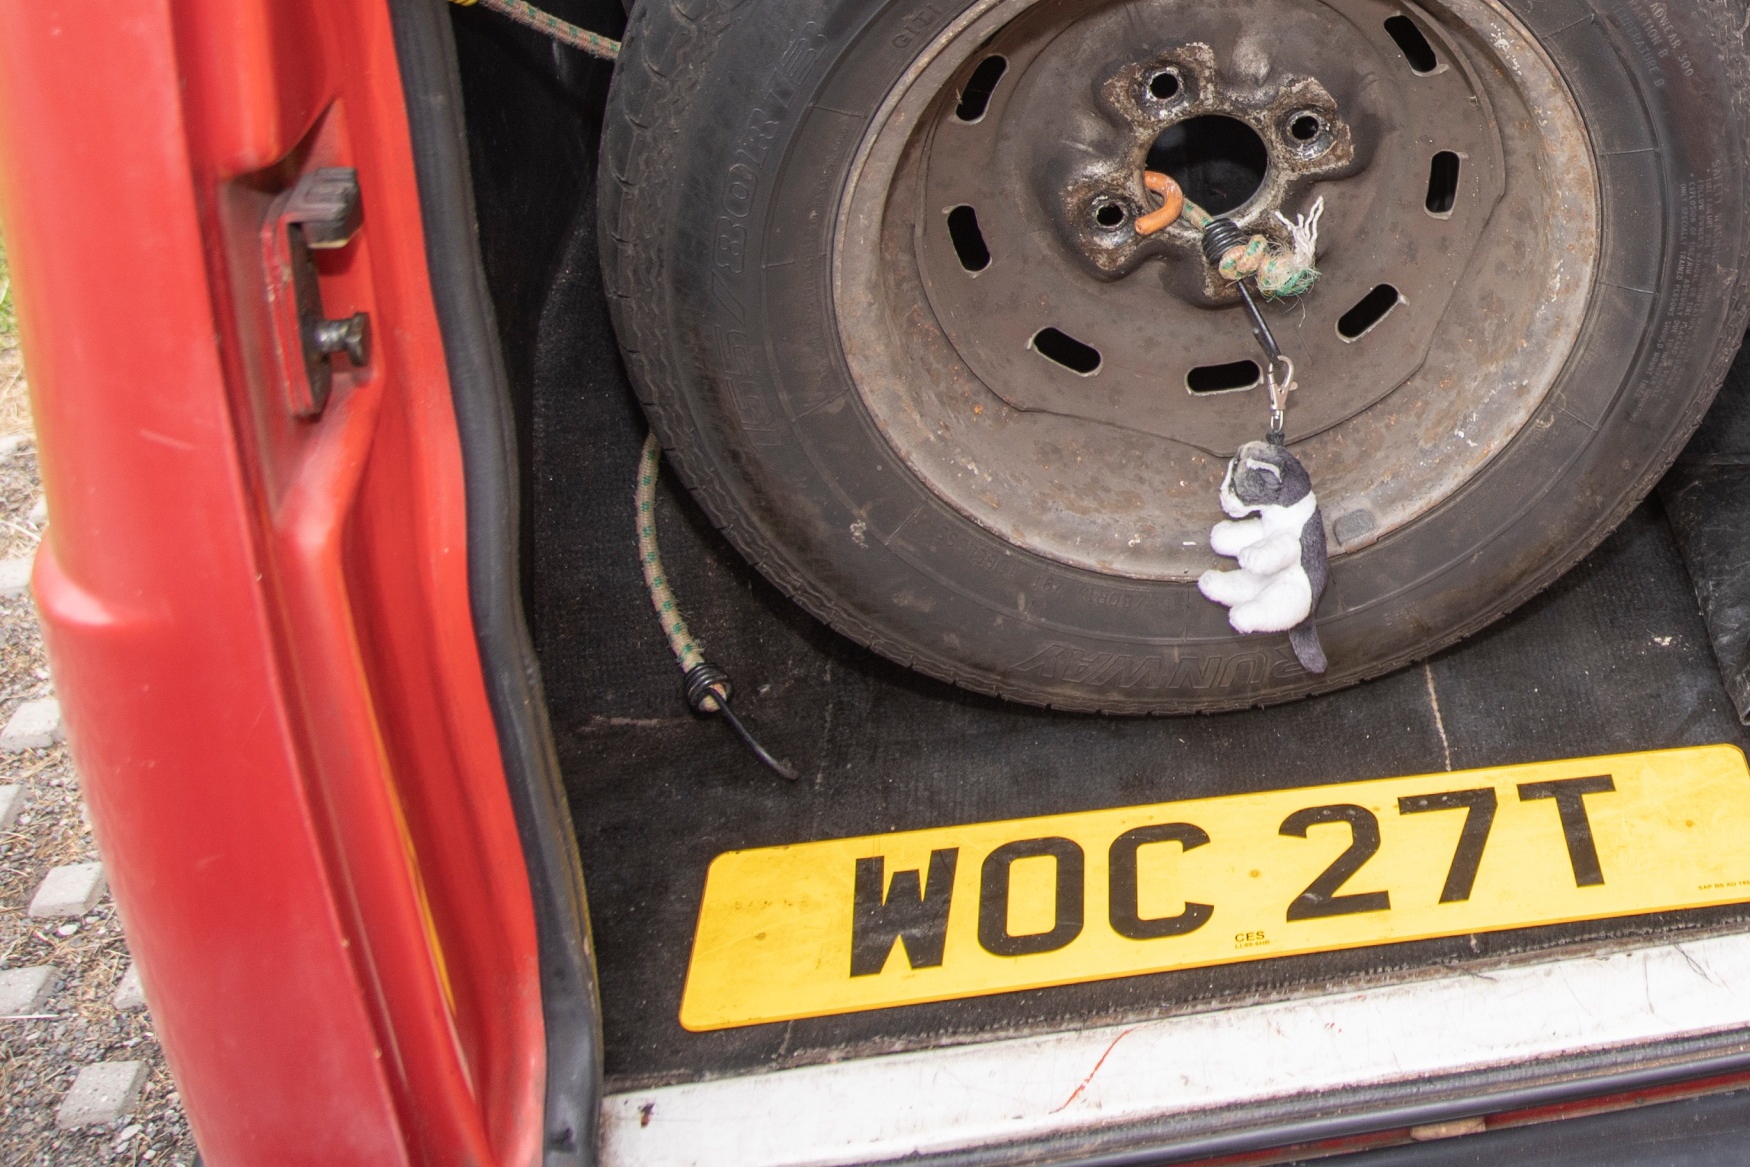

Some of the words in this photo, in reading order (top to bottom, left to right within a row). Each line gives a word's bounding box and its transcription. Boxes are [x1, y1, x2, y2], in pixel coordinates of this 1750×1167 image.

[1610, 2, 1660, 75] TEMPERATURE
[1657, 47, 1669, 59] B
[1677, 51, 1695, 78] 300
[1678, 181, 1688, 203] ONLY
[1696, 178, 1705, 211] FOLLOW
[1709, 157, 1723, 206] SAFETY
[1686, 180, 1697, 223] EXPLOSION
[708, 19, 830, 449] 155/80R13
[1678, 205, 1688, 246] SPECIALLY
[1674, 249, 1687, 281] TRAINED
[1665, 283, 1681, 316] PERSONS
[1674, 277, 1691, 316] ASSEMBLY
[1654, 319, 1672, 349] SHOULD
[1643, 350, 1661, 376] MOUNT
[1011, 642, 1301, 690] RUNWAY
[849, 821, 1215, 979] WOC
[1277, 772, 1617, 924] 27T
[1235, 930, 1265, 942] CES
